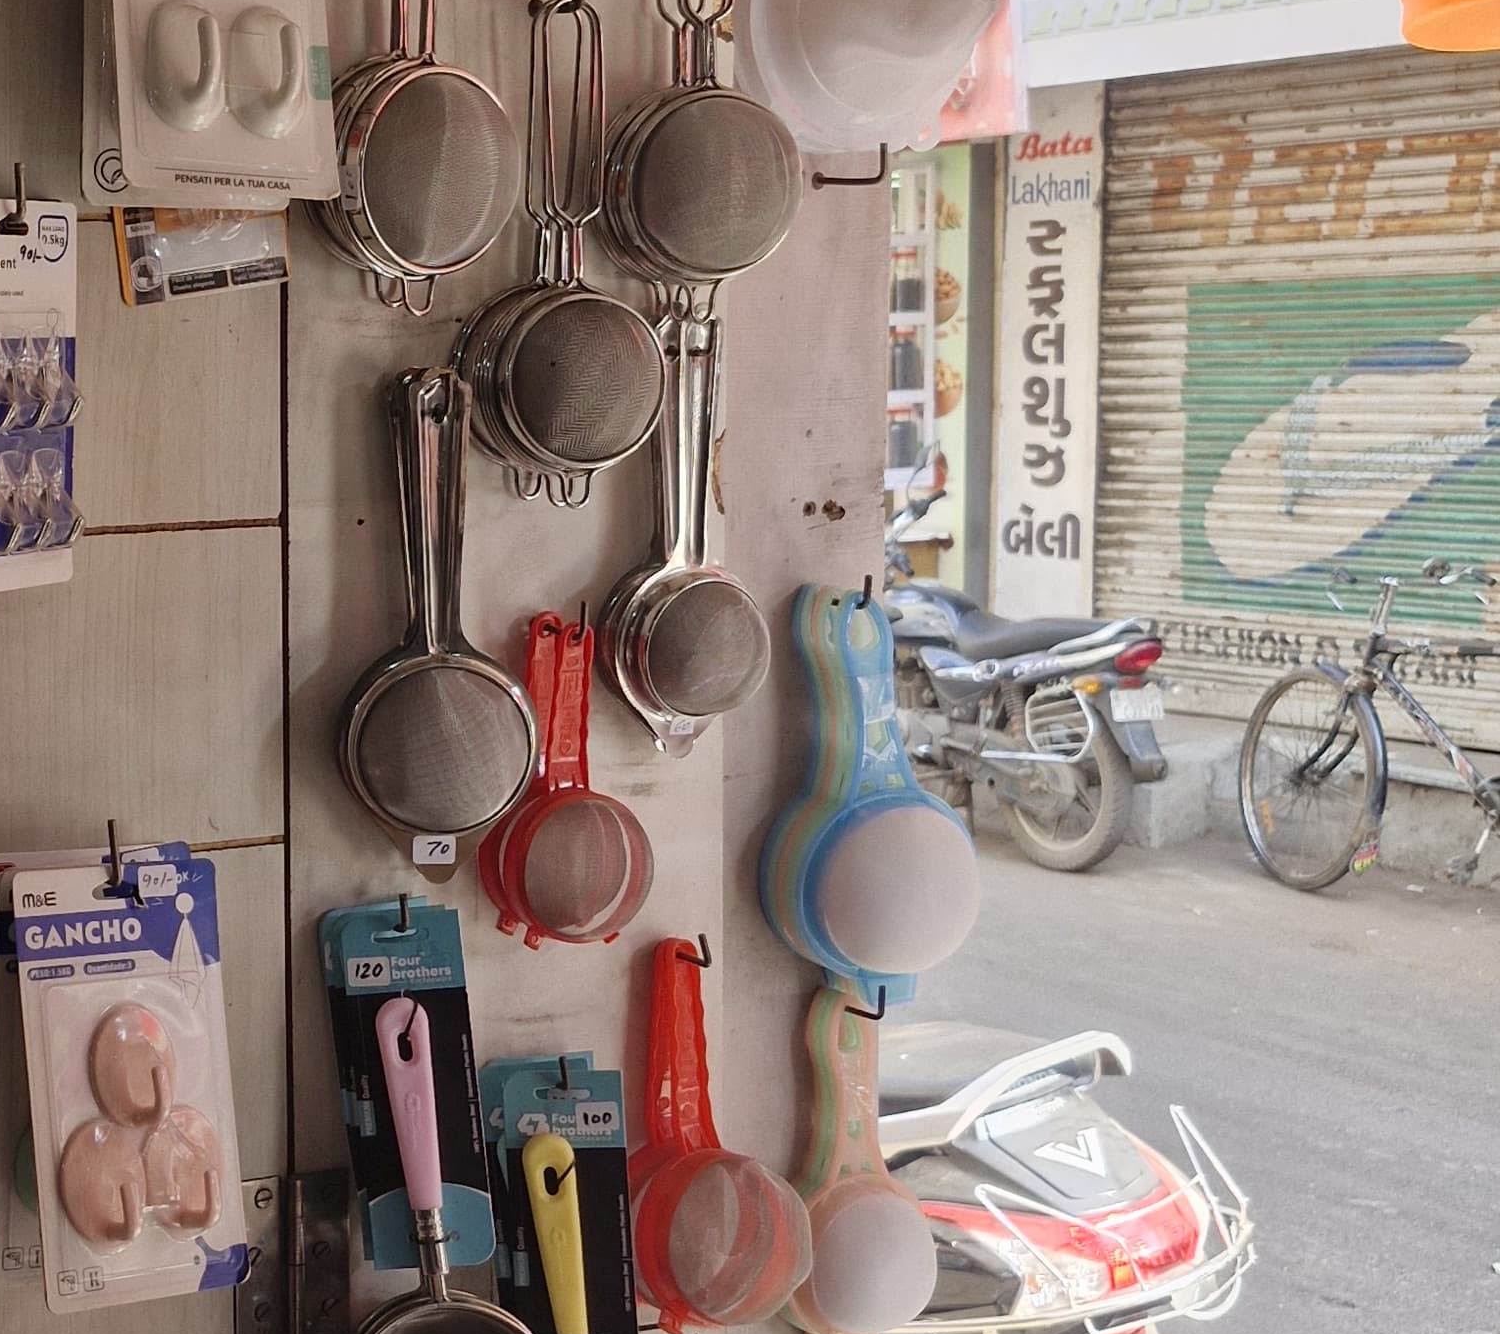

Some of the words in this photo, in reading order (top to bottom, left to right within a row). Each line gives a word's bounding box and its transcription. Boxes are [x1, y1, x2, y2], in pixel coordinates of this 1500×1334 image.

[1015, 130, 1094, 160] Bata
[174, 173, 213, 185] PENSATI
[213, 176, 232, 186] PER
[233, 177, 245, 187] LA
[247, 178, 266, 189] TUA
[267, 180, 291, 191] CASA
[1010, 170, 1091, 208] Lakhani
[427, 841, 450, 856] 70
[142, 872, 174, 887] 90/-
[24, 917, 142, 949] GANCHO
[390, 954, 421, 967] Four
[355, 963, 384, 978] 120
[391, 965, 452, 980] brothers
[583, 1112, 612, 1125] 100
